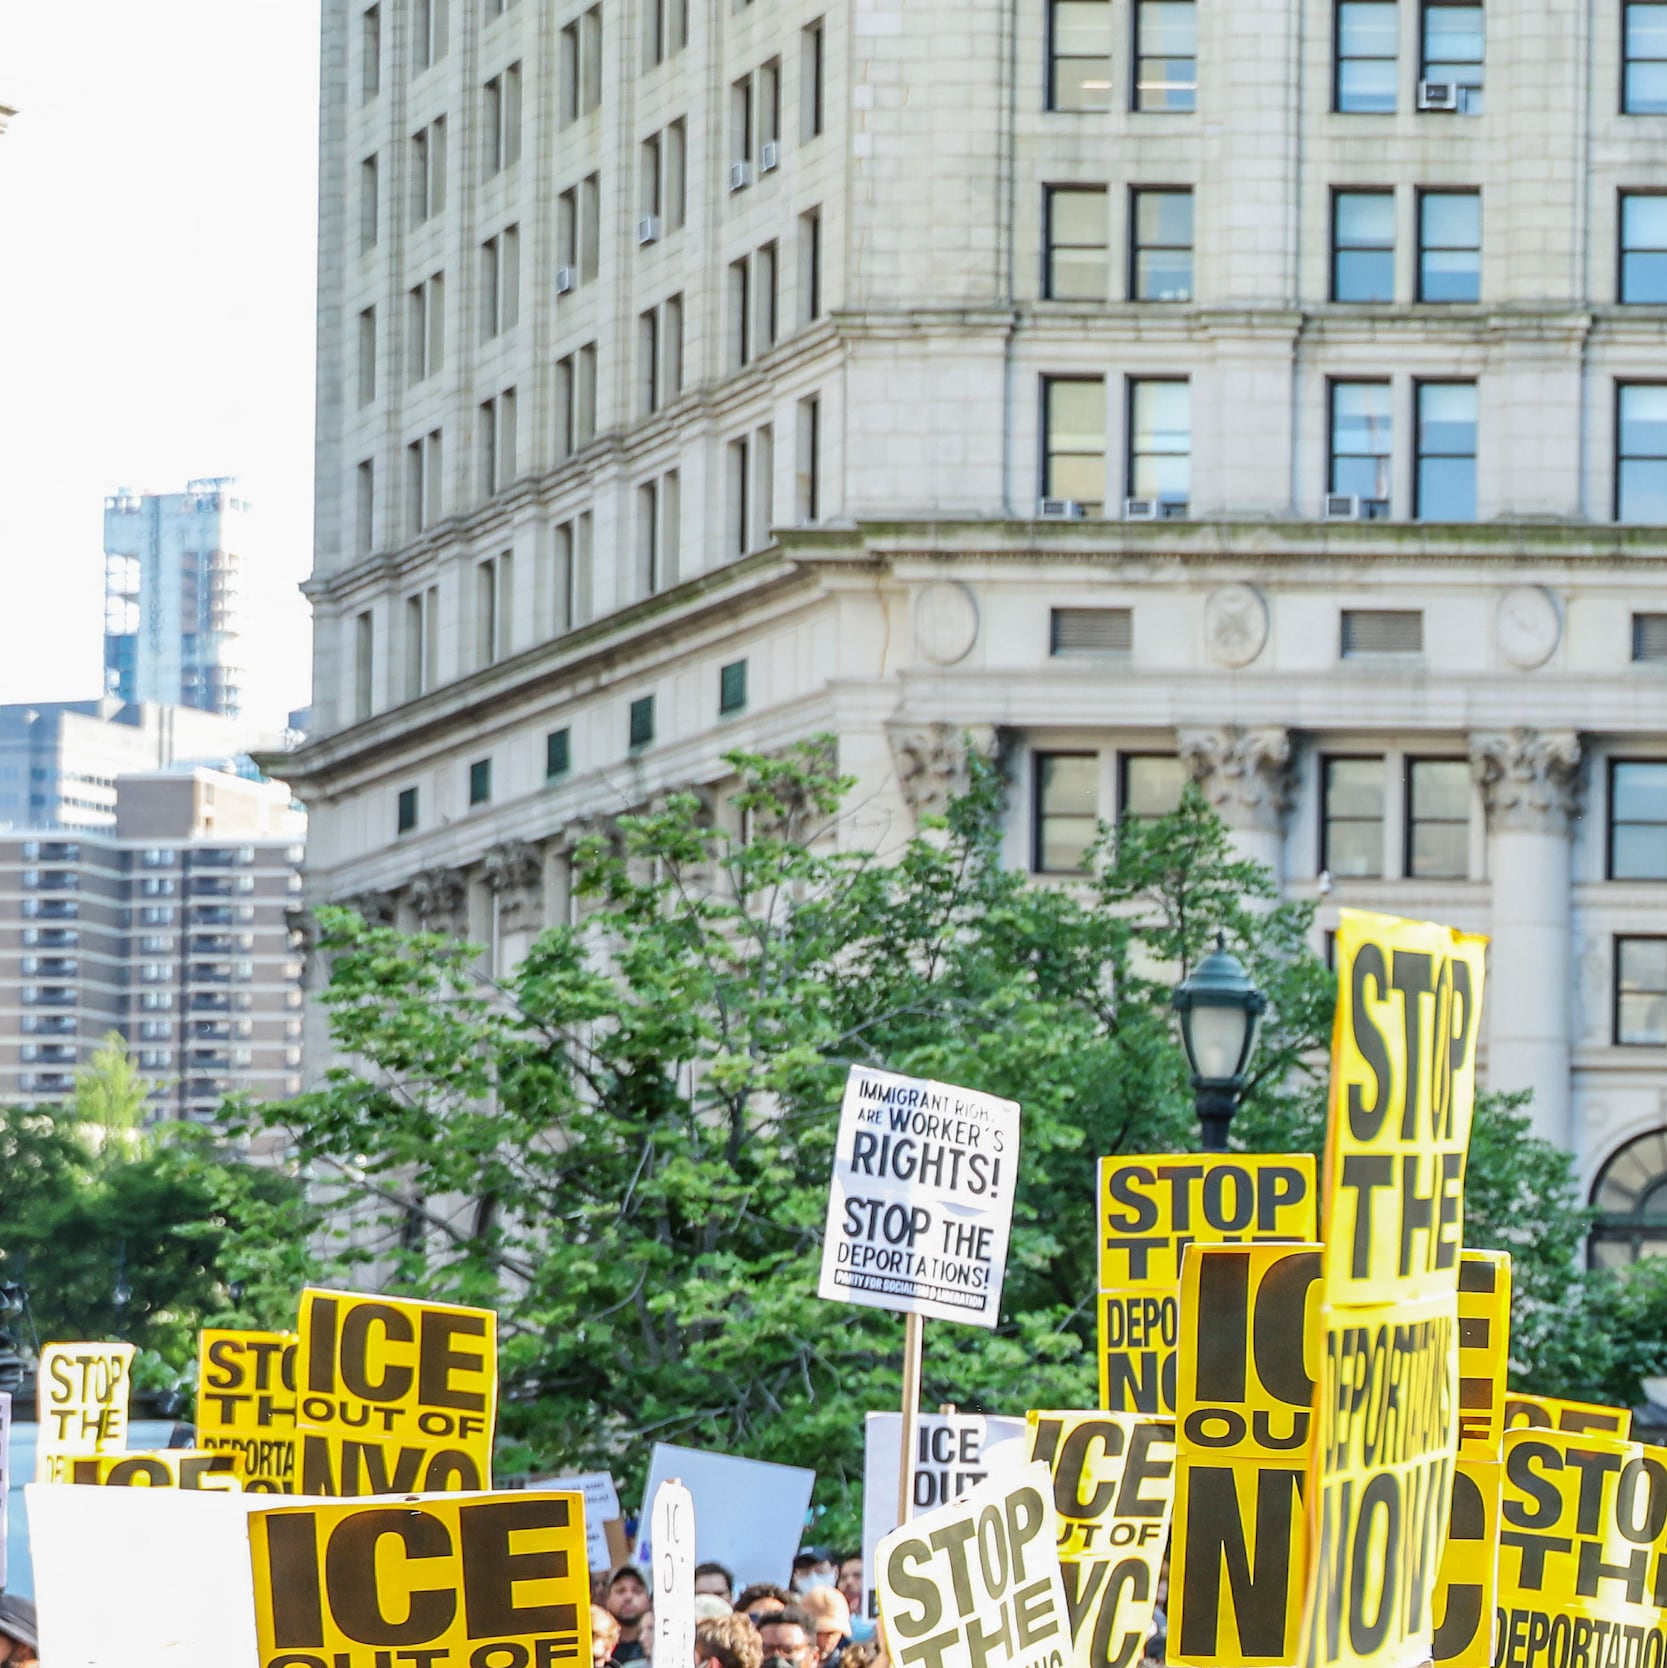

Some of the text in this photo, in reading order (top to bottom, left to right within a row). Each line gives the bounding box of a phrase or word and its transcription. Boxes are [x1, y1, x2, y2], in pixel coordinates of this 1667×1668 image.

[1348, 943, 1471, 1142] STOP
[857, 1108, 883, 1125] ARE
[859, 1080, 950, 1113] IMMIGRANT
[850, 1130, 1001, 1199] RIGHTS!
[1107, 1165, 1306, 1232] STOP
[1342, 1153, 1462, 1280] THE
[842, 1197, 994, 1262] STOP THE
[837, 1243, 991, 1290] DEPORTATIONS!
[864, 1277, 882, 1289] FOR
[51, 1355, 123, 1403] STOP
[308, 1298, 486, 1413] ICE
[51, 1409, 119, 1441] THE
[302, 1397, 485, 1440] OUT OF
[920, 1427, 978, 1465] ICE
[1030, 1419, 1175, 1518] ICE
[887, 1486, 1044, 1639] STOP
[1109, 1524, 1159, 1547] OF
[266, 1500, 579, 1649] ICE
